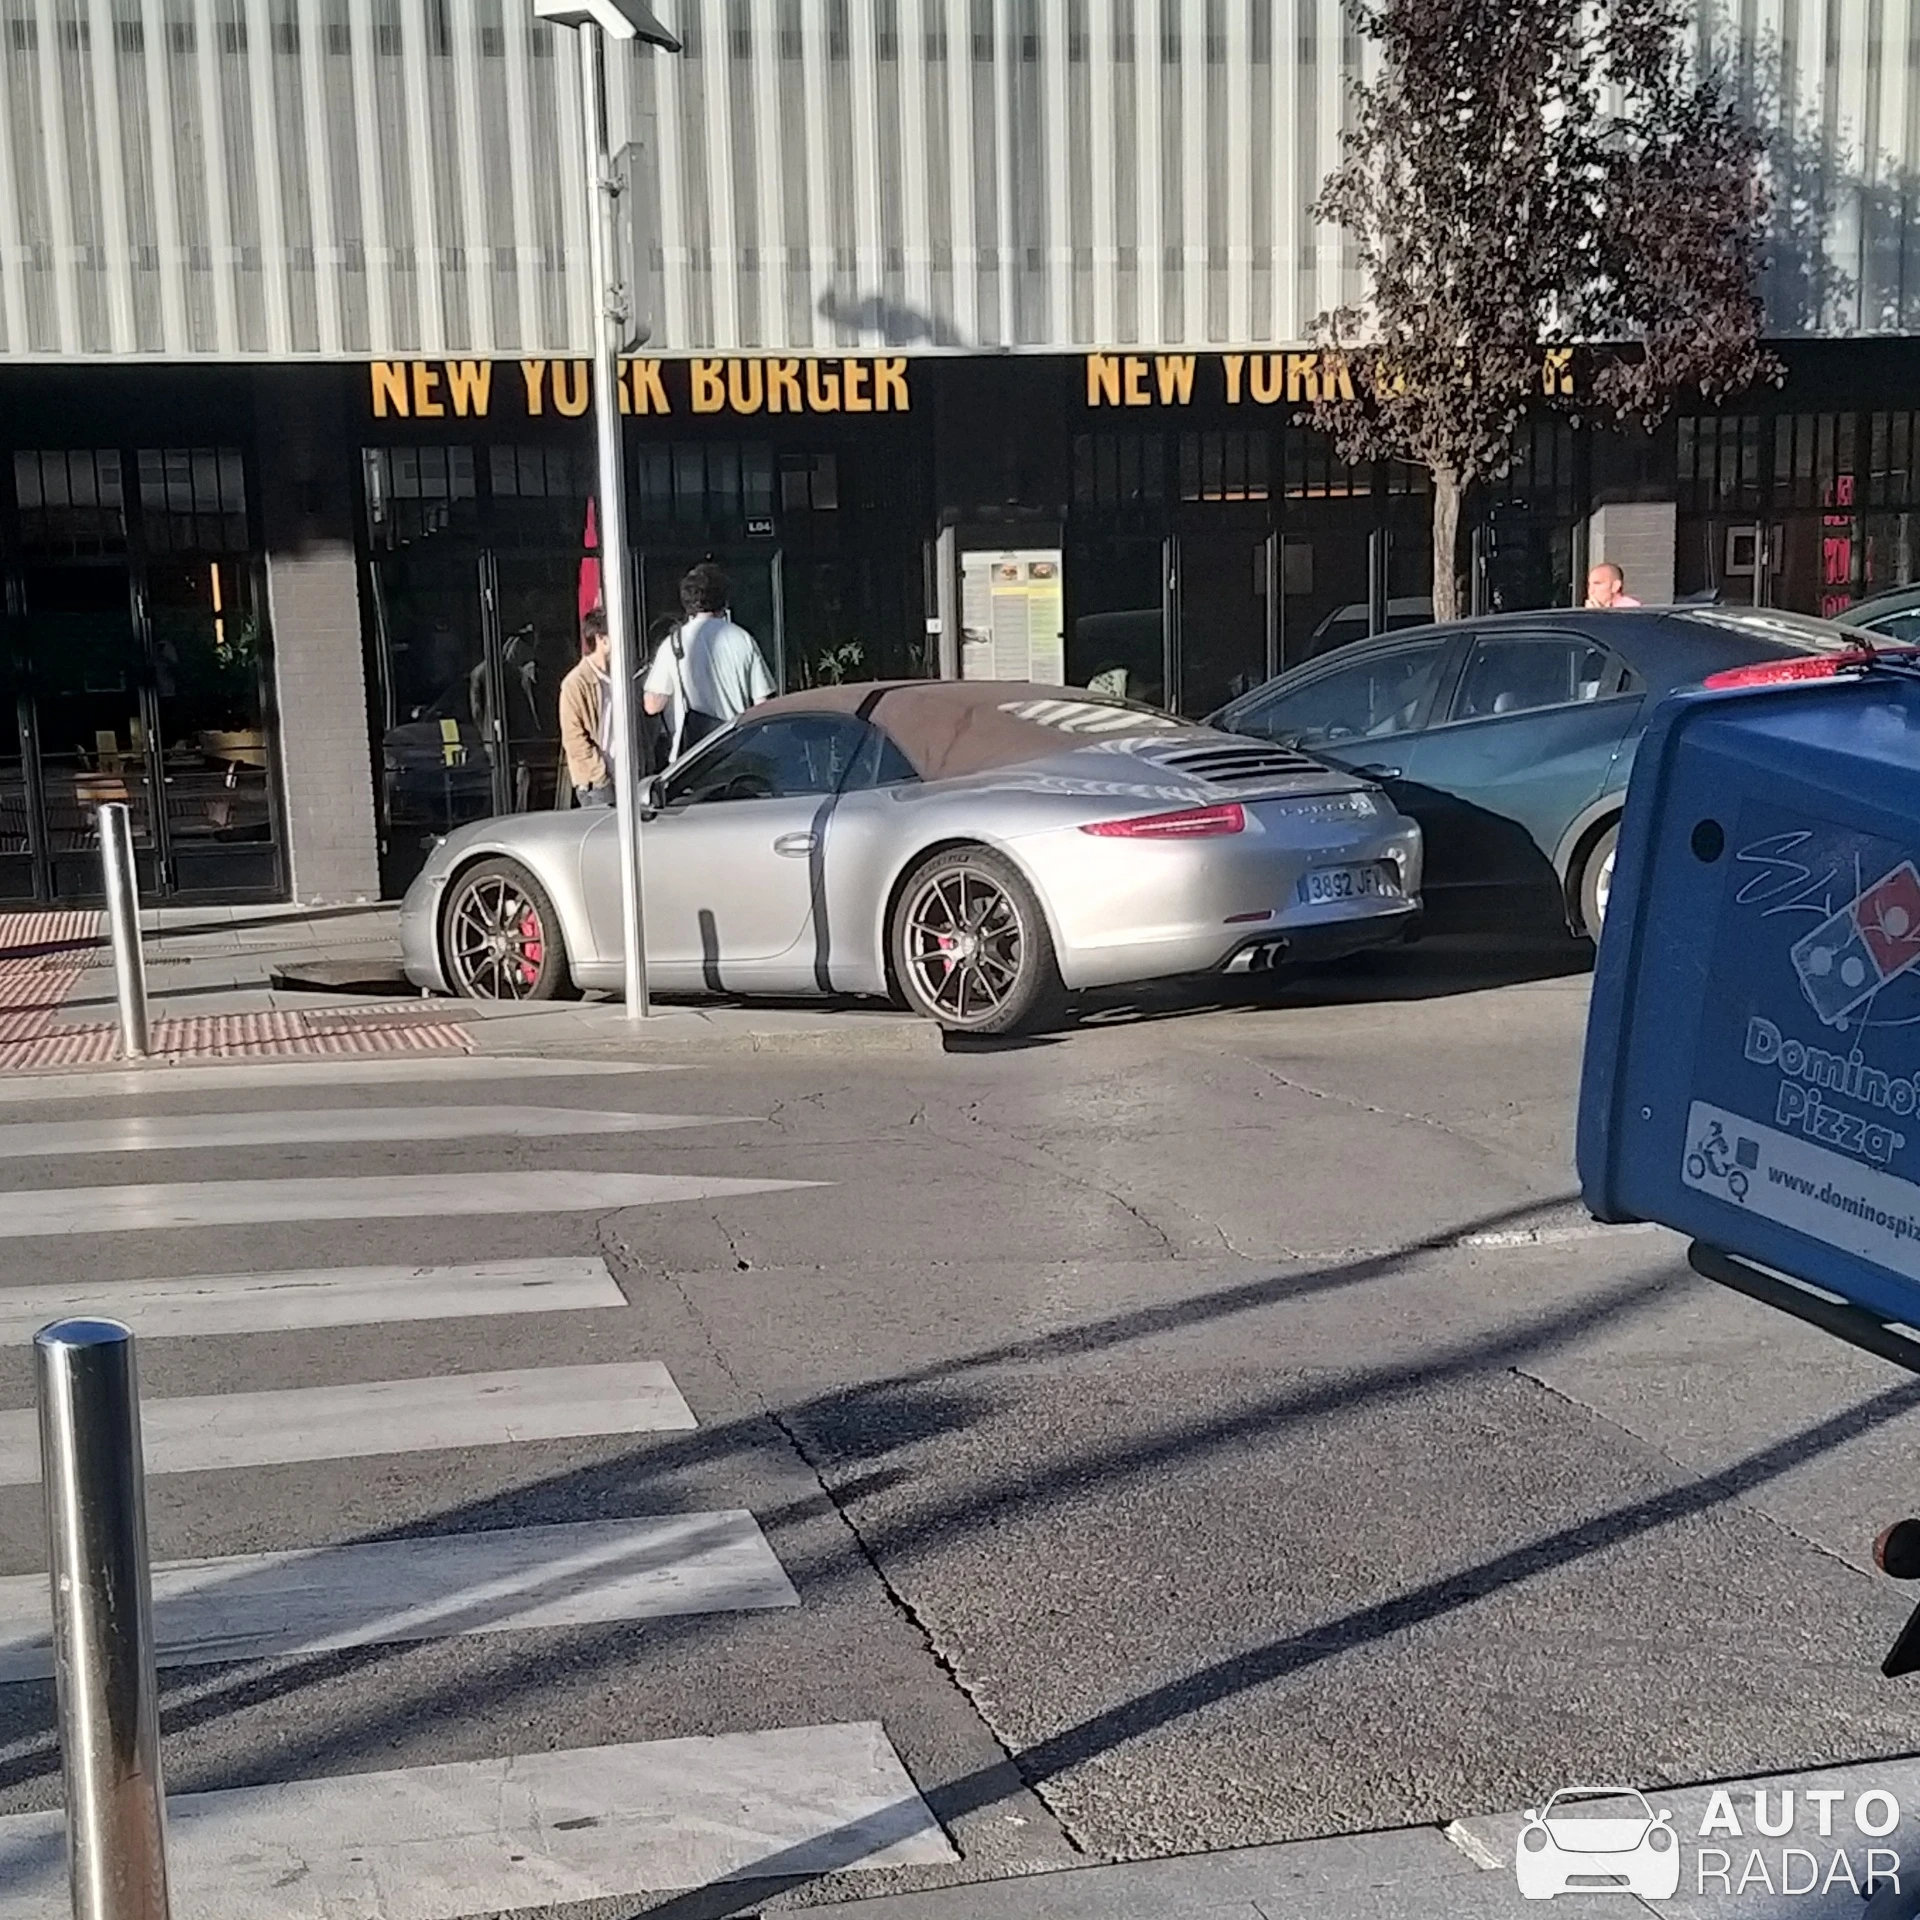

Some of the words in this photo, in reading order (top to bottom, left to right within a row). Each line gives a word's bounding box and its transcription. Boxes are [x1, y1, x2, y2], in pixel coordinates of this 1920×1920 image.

[370, 361, 492, 418] NEW
[691, 357, 910, 414] BURGER
[1087, 355, 1196, 406] NEW
[1312, 873, 1353, 899] 3892
[1775, 1080, 1895, 1163] Pizza
